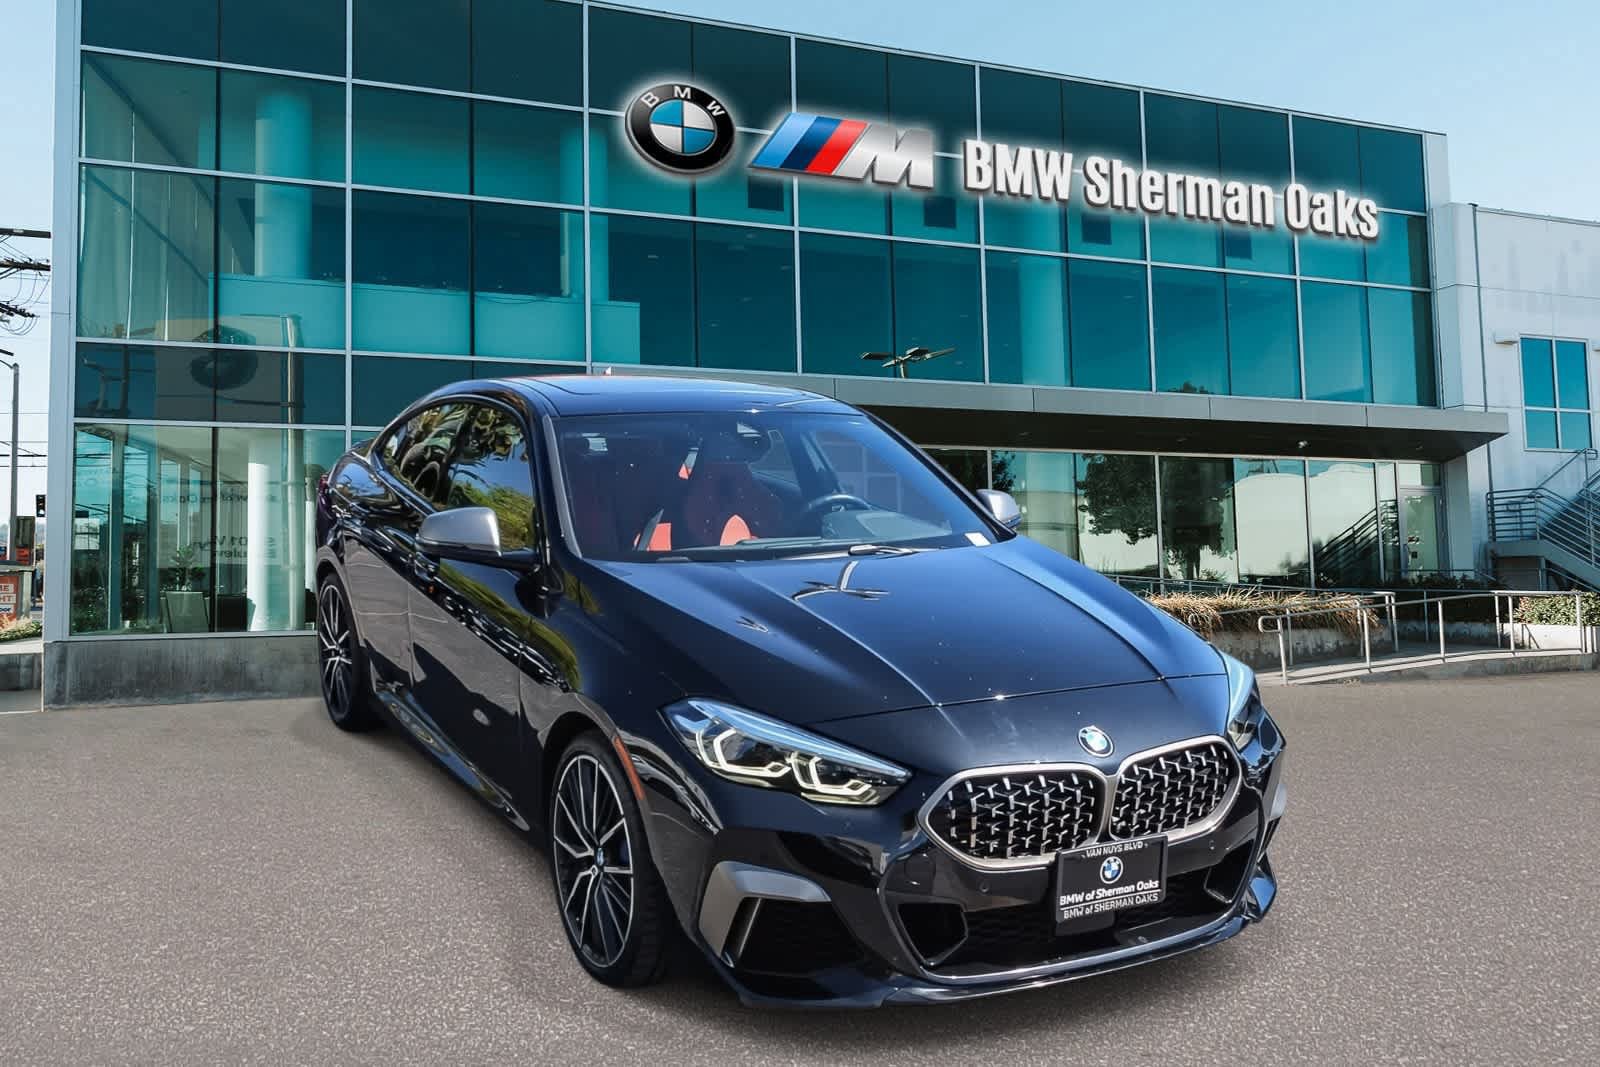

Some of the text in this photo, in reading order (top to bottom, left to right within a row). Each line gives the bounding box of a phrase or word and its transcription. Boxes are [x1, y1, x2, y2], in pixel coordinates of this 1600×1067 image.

[641, 84, 726, 117] BMW
[964, 138, 1380, 240] BMW Sherman Oaks
[1086, 840, 1144, 858] VAN NUYS BLVD
[1060, 879, 1160, 906] BMW of Sherman Oaks
[1063, 892, 1159, 919] BMW of SHERMAN OAKS
